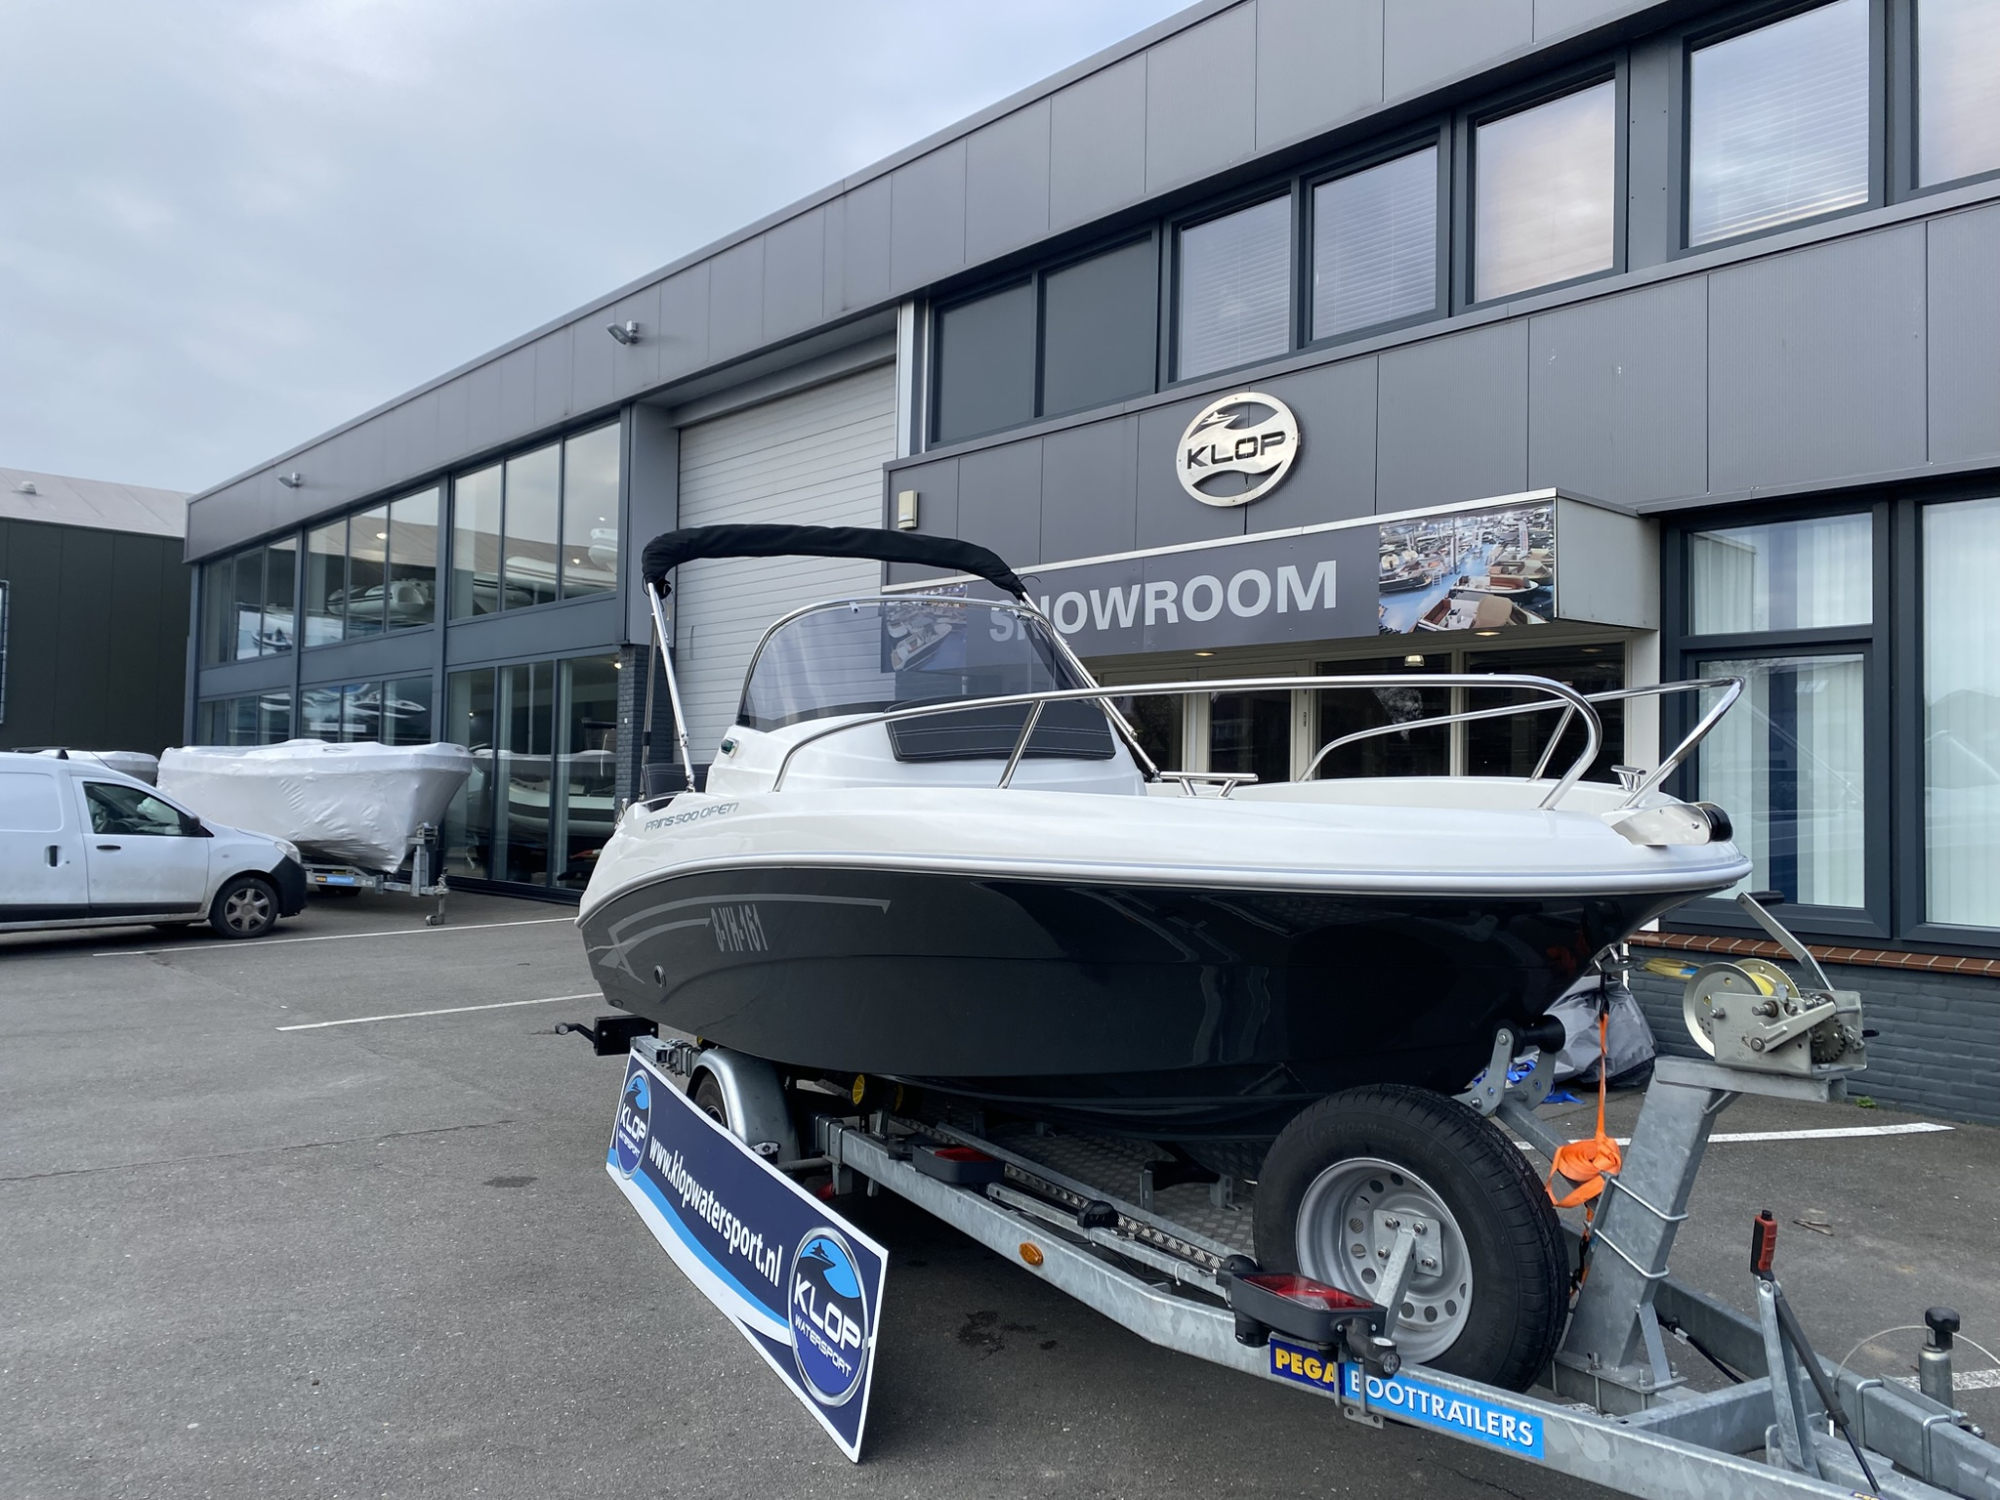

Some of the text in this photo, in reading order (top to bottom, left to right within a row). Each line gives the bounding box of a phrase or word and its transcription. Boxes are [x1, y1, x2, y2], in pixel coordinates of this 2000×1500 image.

[1187, 430, 1286, 470] KLOP
[674, 811, 700, 825] 500
[700, 802, 740, 819] OPEN
[711, 903, 769, 952] 8-YH-161
[620, 1103, 647, 1143] KLOP
[649, 1136, 783, 1288] www.klopwatersport.nl
[794, 1272, 861, 1350] KLOP
[795, 1314, 852, 1377] WATERSPORT
